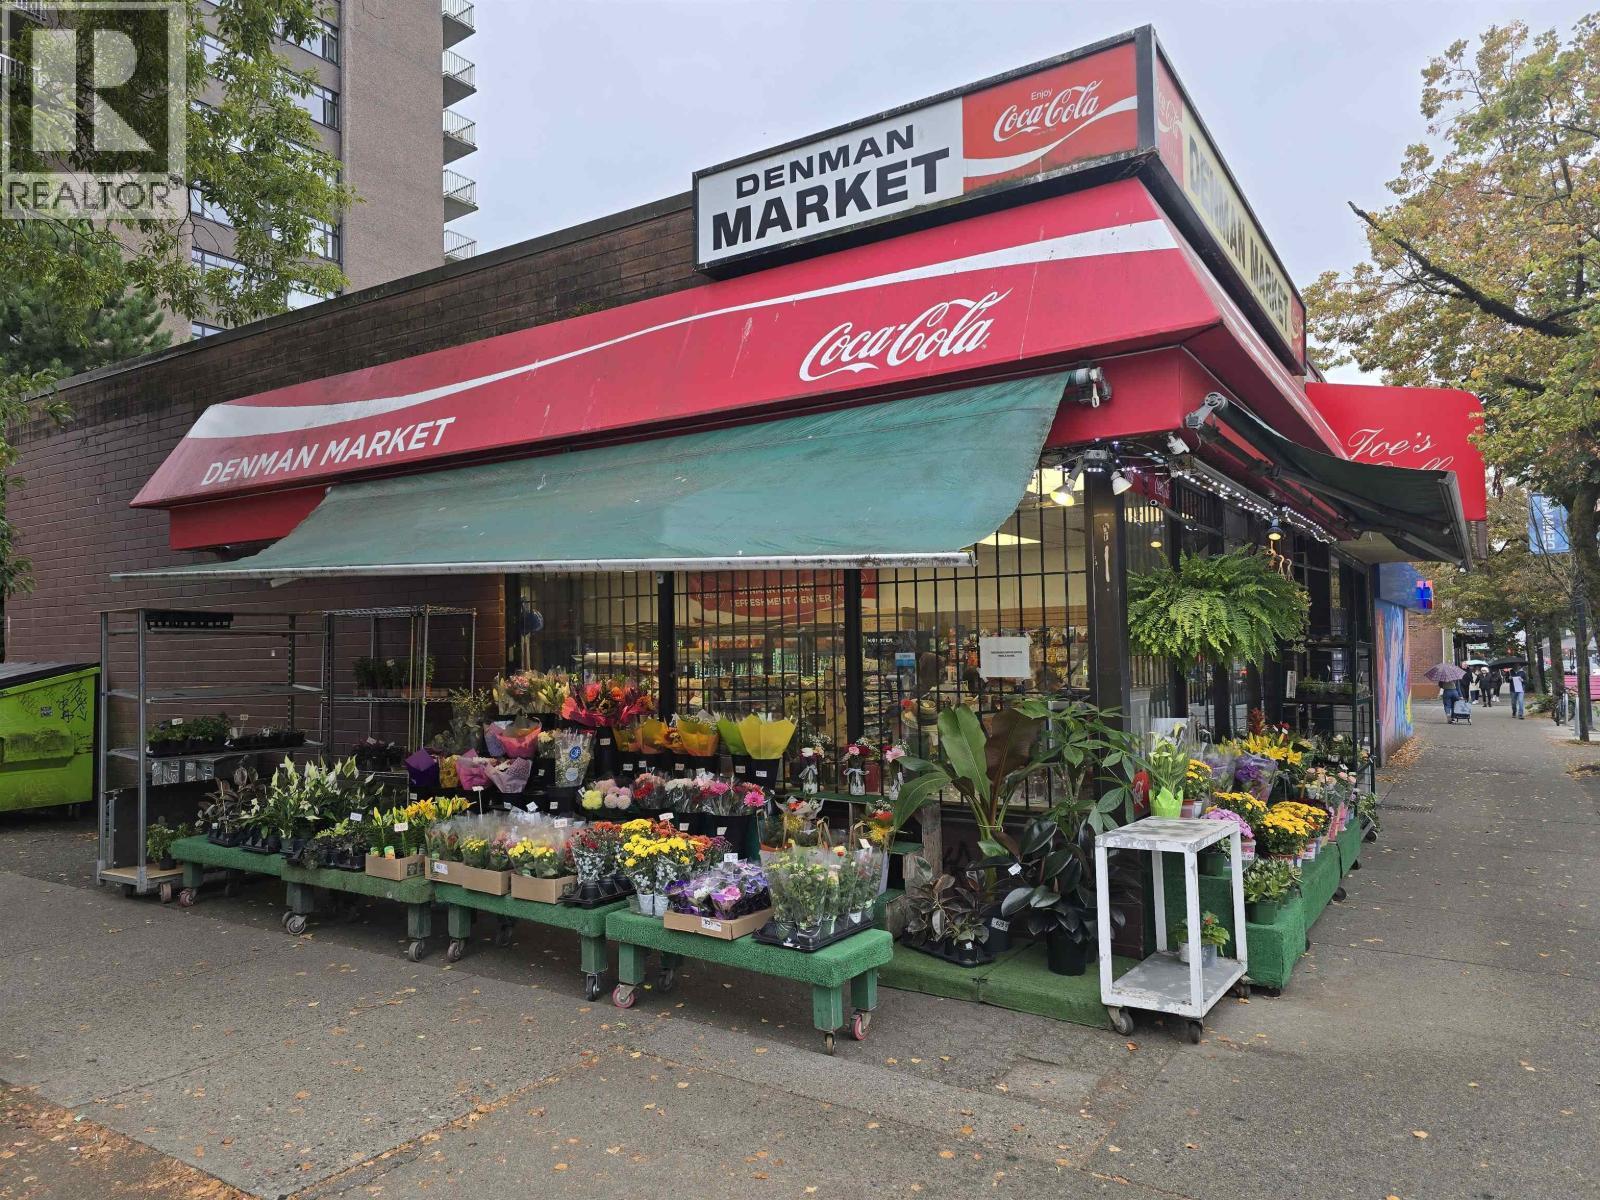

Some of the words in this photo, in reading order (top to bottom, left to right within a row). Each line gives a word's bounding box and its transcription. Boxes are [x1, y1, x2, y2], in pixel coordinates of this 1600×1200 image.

[993, 80, 1103, 142] Coca-Cola
[1031, 88, 1053, 100] Enjoy
[736, 124, 914, 199] DENMAN
[713, 147, 950, 250] MARKET
[1189, 133, 1246, 270] DENMAN
[1250, 235, 1289, 332] MARKET
[799, 287, 1014, 382] Coca-Cola
[201, 443, 319, 486] DENMAN
[320, 416, 456, 466] MARKET
[1347, 427, 1439, 461] Joe's
